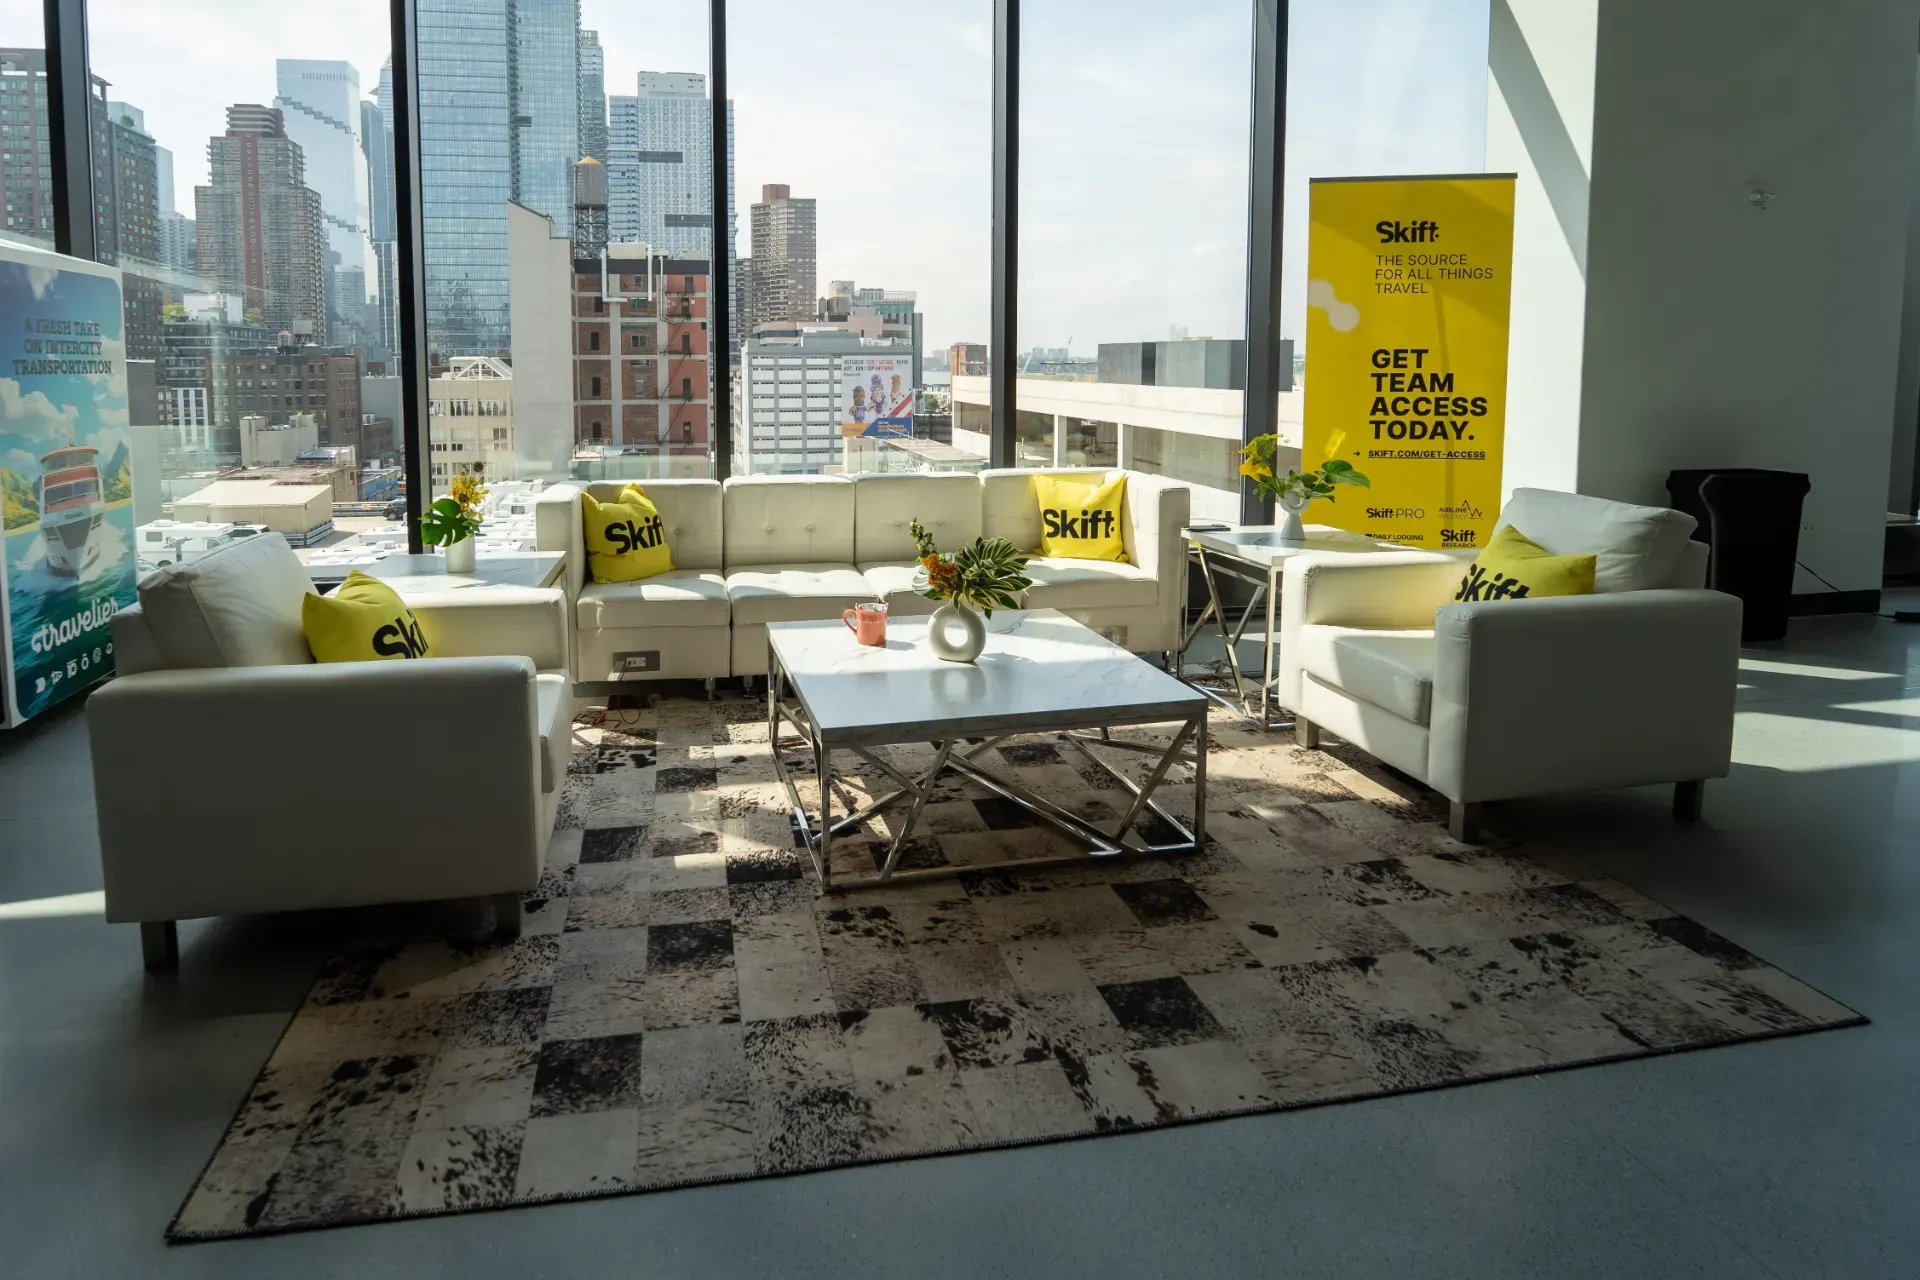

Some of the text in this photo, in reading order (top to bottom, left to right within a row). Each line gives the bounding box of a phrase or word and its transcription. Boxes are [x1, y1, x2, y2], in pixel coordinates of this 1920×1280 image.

[1377, 254, 1468, 266] THE SOURCE
[1375, 268, 1494, 280] FOR ALL THINGS
[1375, 282, 1428, 294] TRAVEL
[35, 319, 72, 335] FRESH
[73, 321, 100, 336] TAKE
[24, 339, 102, 356] ON INTERCITY
[12, 359, 112, 375] TRANSPORTATION
[1371, 348, 1429, 369] GET
[1370, 372, 1455, 393] TEAM
[1369, 396, 1488, 417] ACCESS
[1369, 420, 1475, 441] TODAY.
[1368, 450, 1486, 460] SKIFT.COM/GET-ACCESS
[604, 514, 664, 555] Skif
